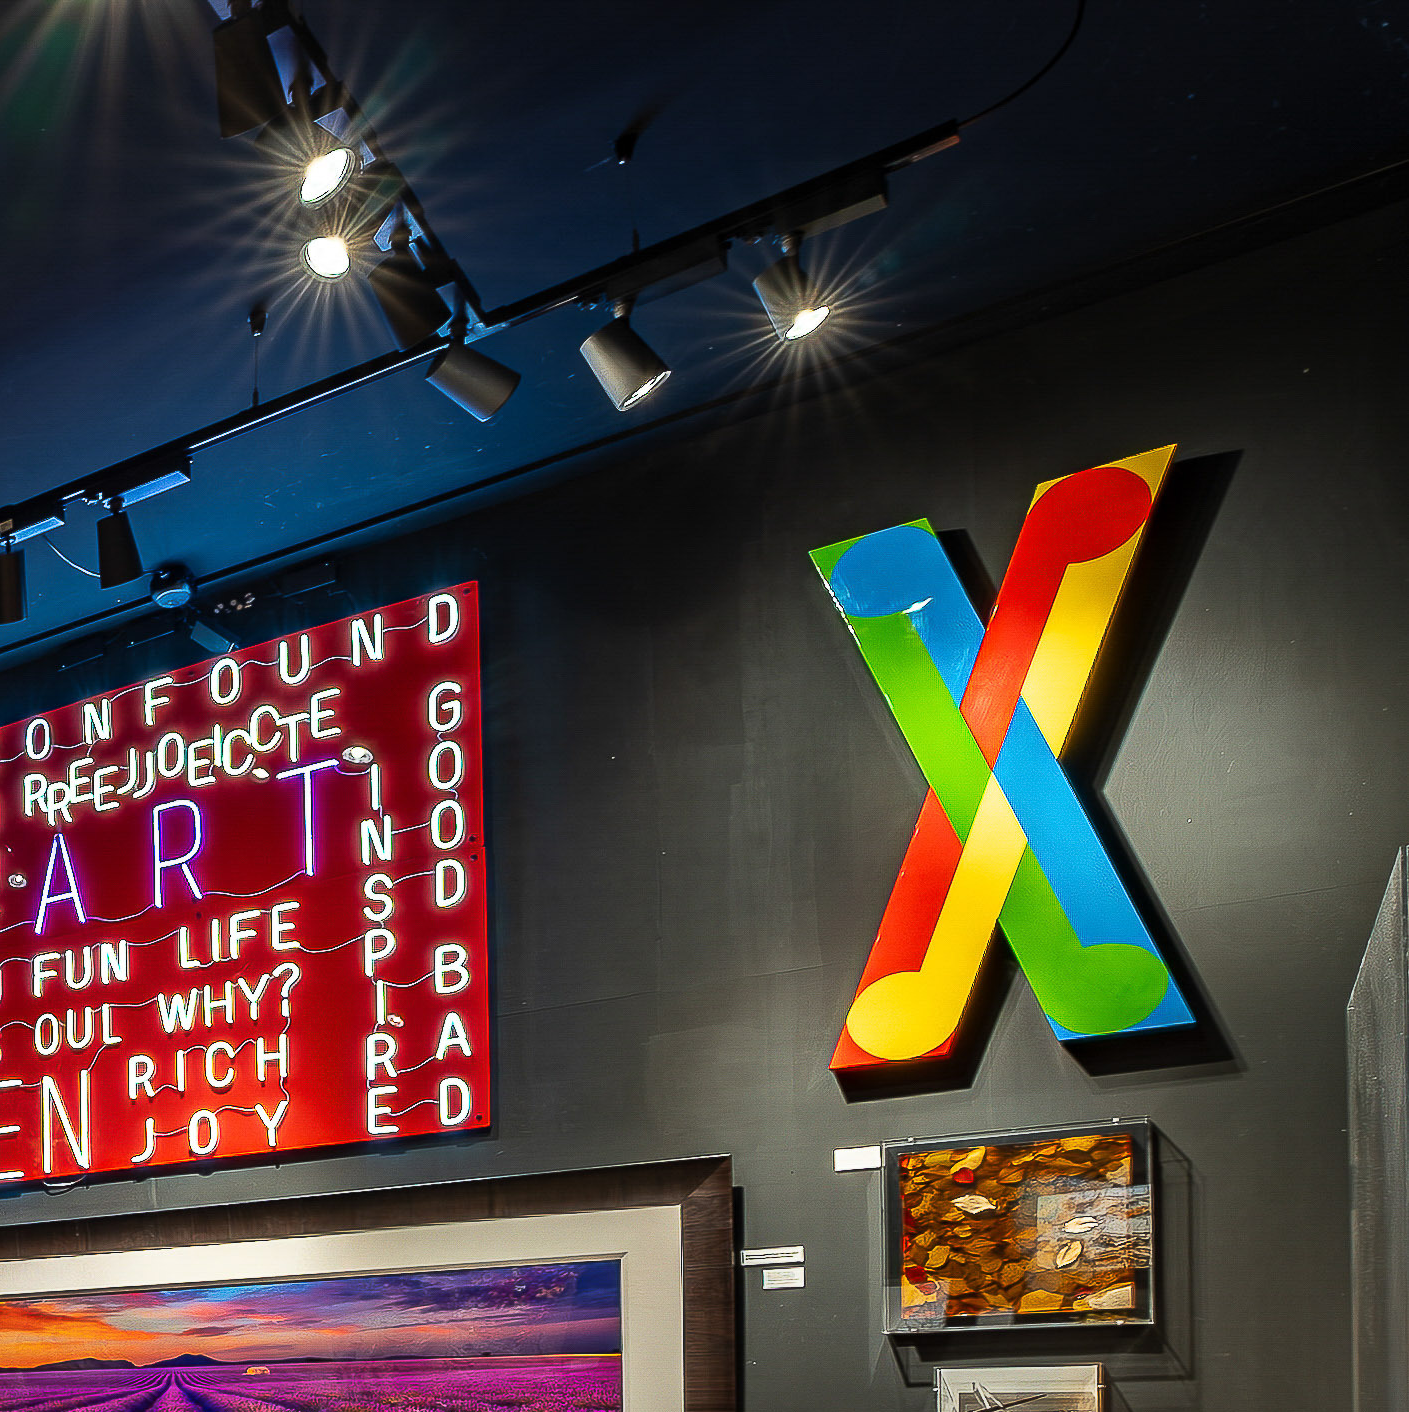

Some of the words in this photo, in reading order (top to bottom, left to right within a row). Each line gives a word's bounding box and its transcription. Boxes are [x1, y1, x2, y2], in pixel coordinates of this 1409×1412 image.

[427, 681, 466, 907] GOOD
[34, 758, 339, 934] ART
[32, 940, 129, 998] FUN
[177, 902, 302, 969] LIFE
[157, 962, 302, 1033] WHY?
[127, 1034, 289, 1100] RICH
[433, 943, 472, 1126] BAD
[131, 1100, 289, 1163] JOY
